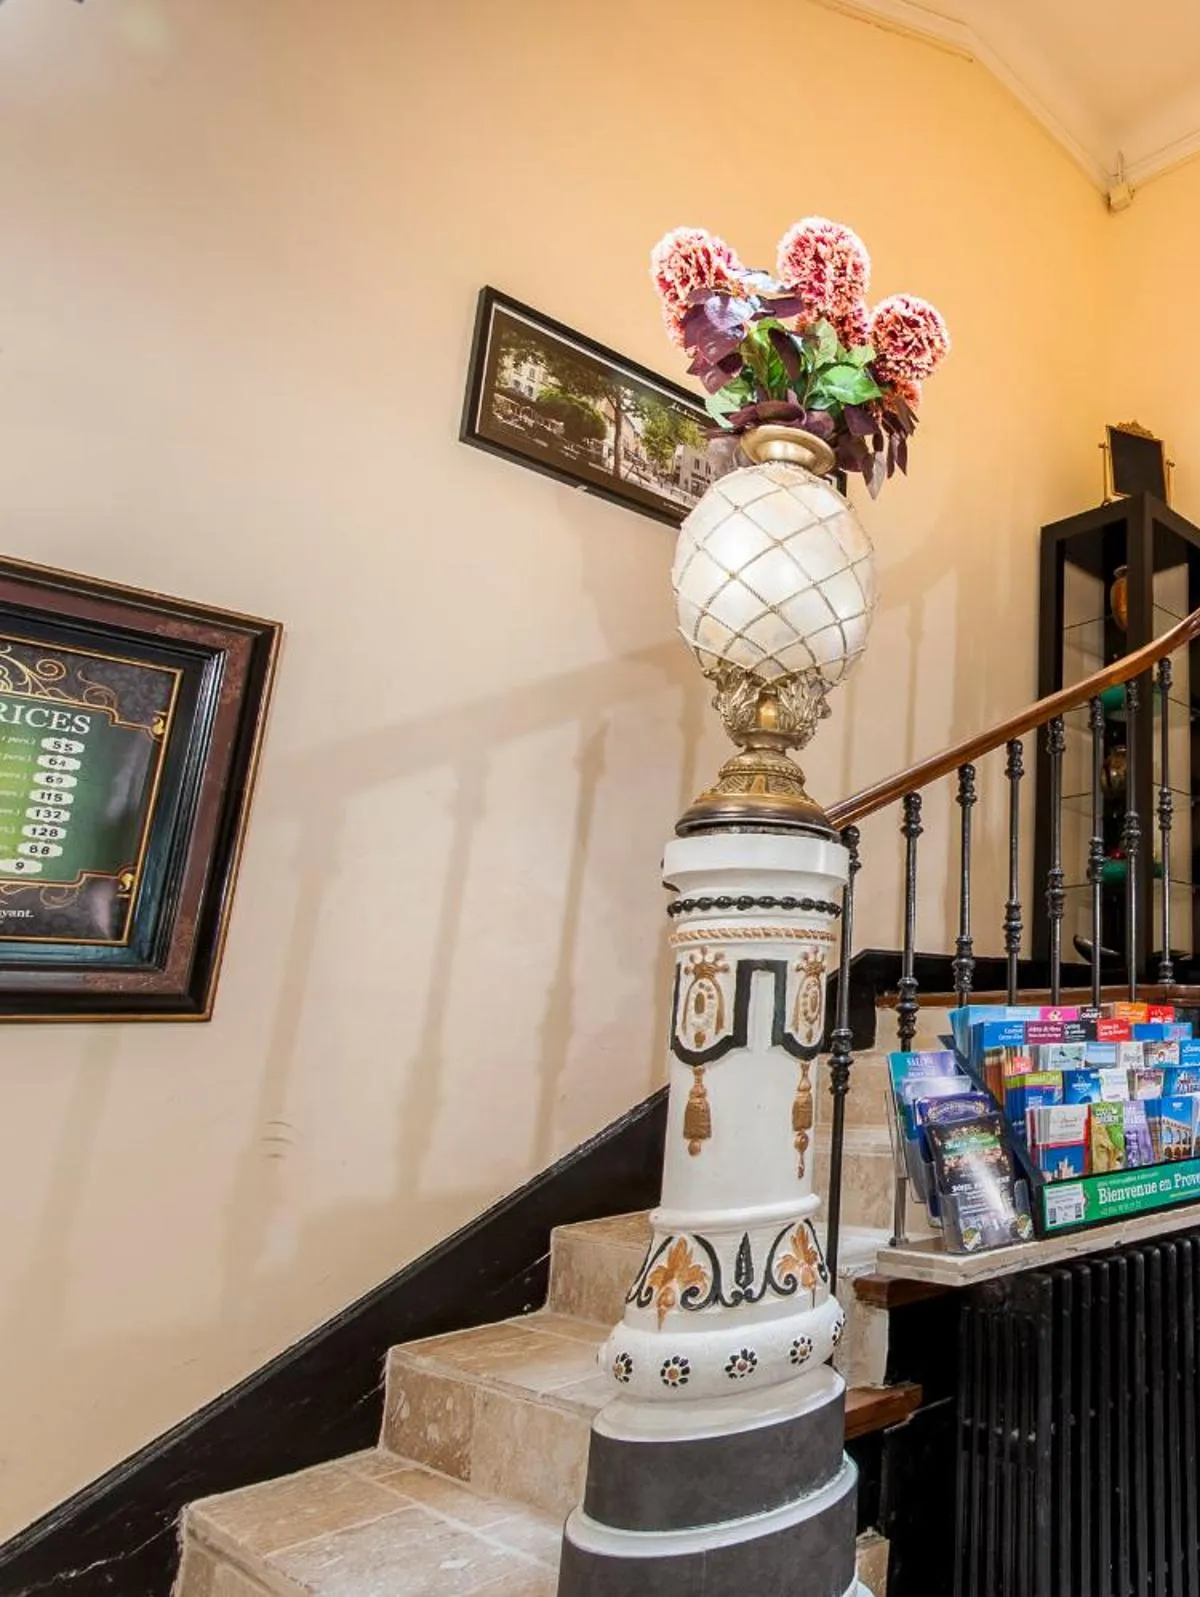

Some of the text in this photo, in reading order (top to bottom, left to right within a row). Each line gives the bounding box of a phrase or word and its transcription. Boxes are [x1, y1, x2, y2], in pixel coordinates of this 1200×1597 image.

[53, 740, 73, 752] 55
[40, 791, 63, 802] 115
[35, 808, 62, 819] 132
[31, 826, 59, 837] 128
[1098, 1182, 1157, 1204] Bienvenue
[1159, 1180, 1172, 1192] en
